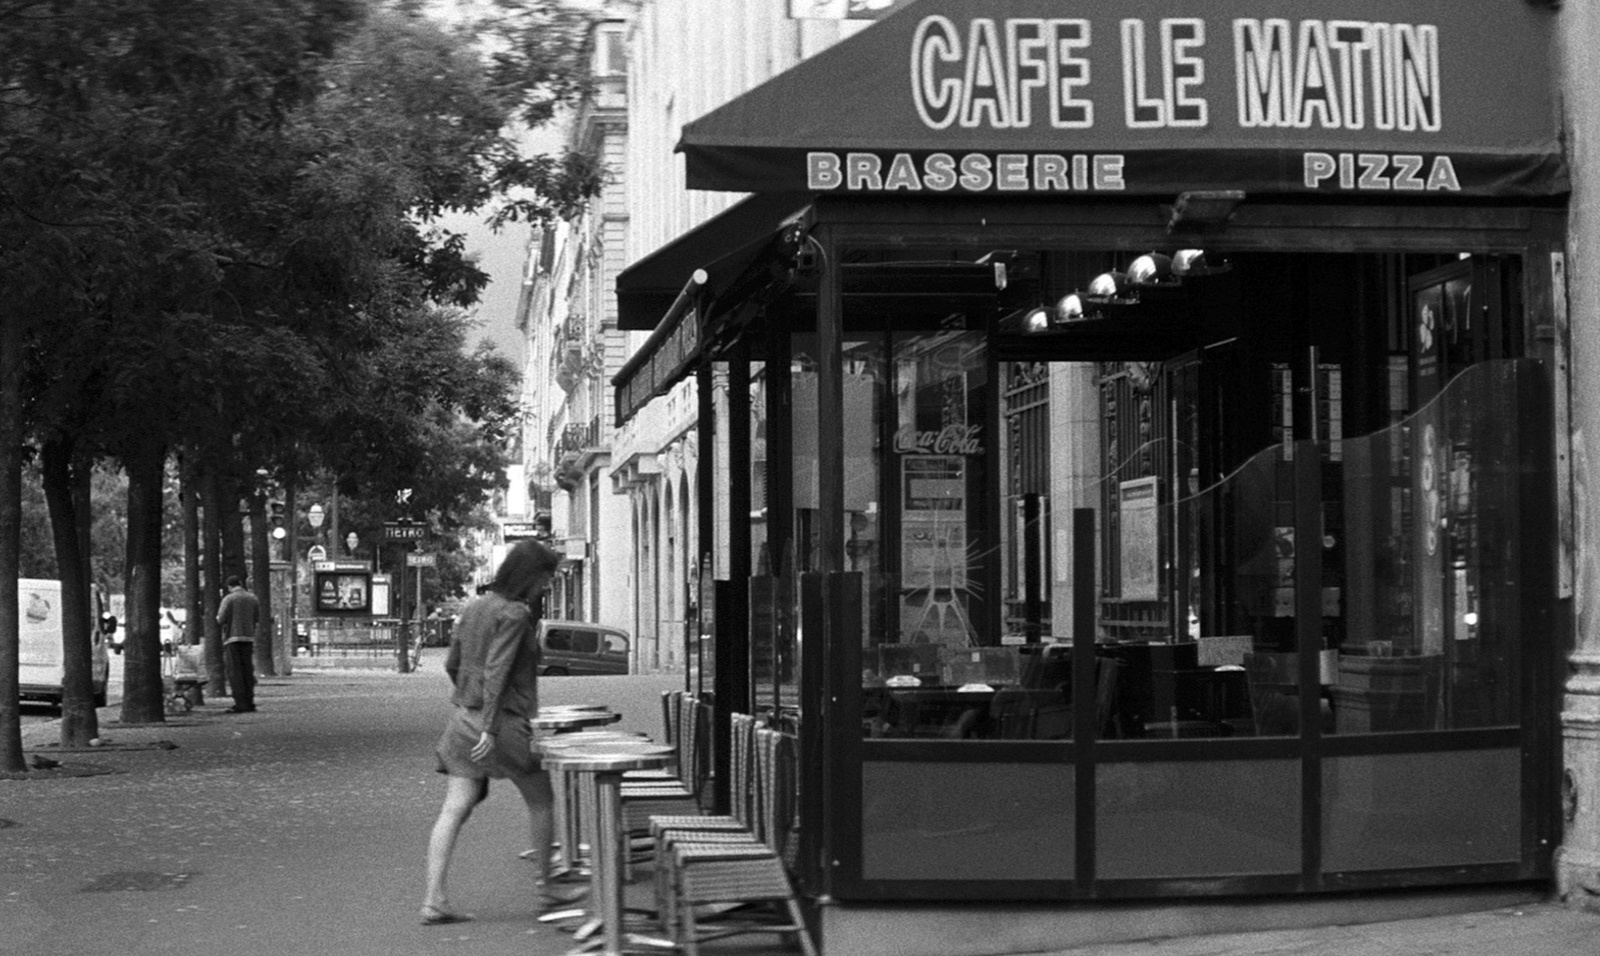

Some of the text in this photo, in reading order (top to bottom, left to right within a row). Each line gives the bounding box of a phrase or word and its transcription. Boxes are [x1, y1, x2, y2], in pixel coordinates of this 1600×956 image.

[911, 15, 1442, 132] CAFE LE MATIN
[807, 152, 1461, 191] BRASSERIE PIZZA
[893, 423, 983, 454] Coca-Cola
